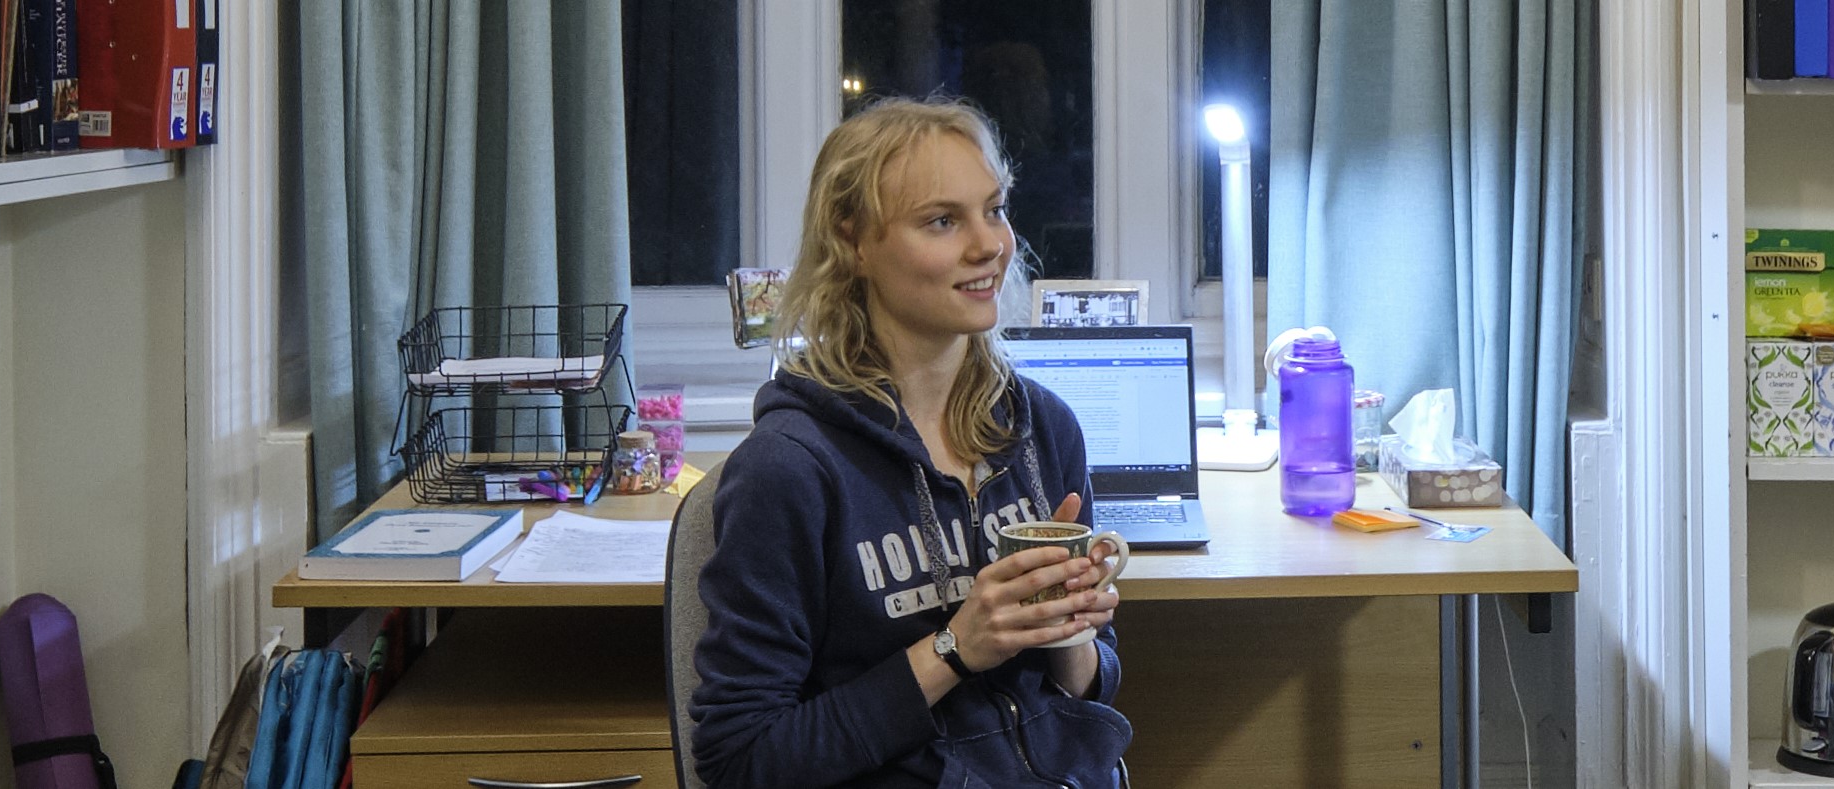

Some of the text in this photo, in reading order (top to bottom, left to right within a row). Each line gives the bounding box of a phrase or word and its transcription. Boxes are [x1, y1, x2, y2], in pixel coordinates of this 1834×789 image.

[176, 71, 184, 91] 4
[204, 66, 211, 87] 4
[173, 91, 187, 102] YEAR
[1752, 255, 1818, 268] TWININGS
[1754, 277, 1786, 287] lemon
[1754, 287, 1802, 296] GREEN TEA
[1765, 370, 1798, 381] pukka
